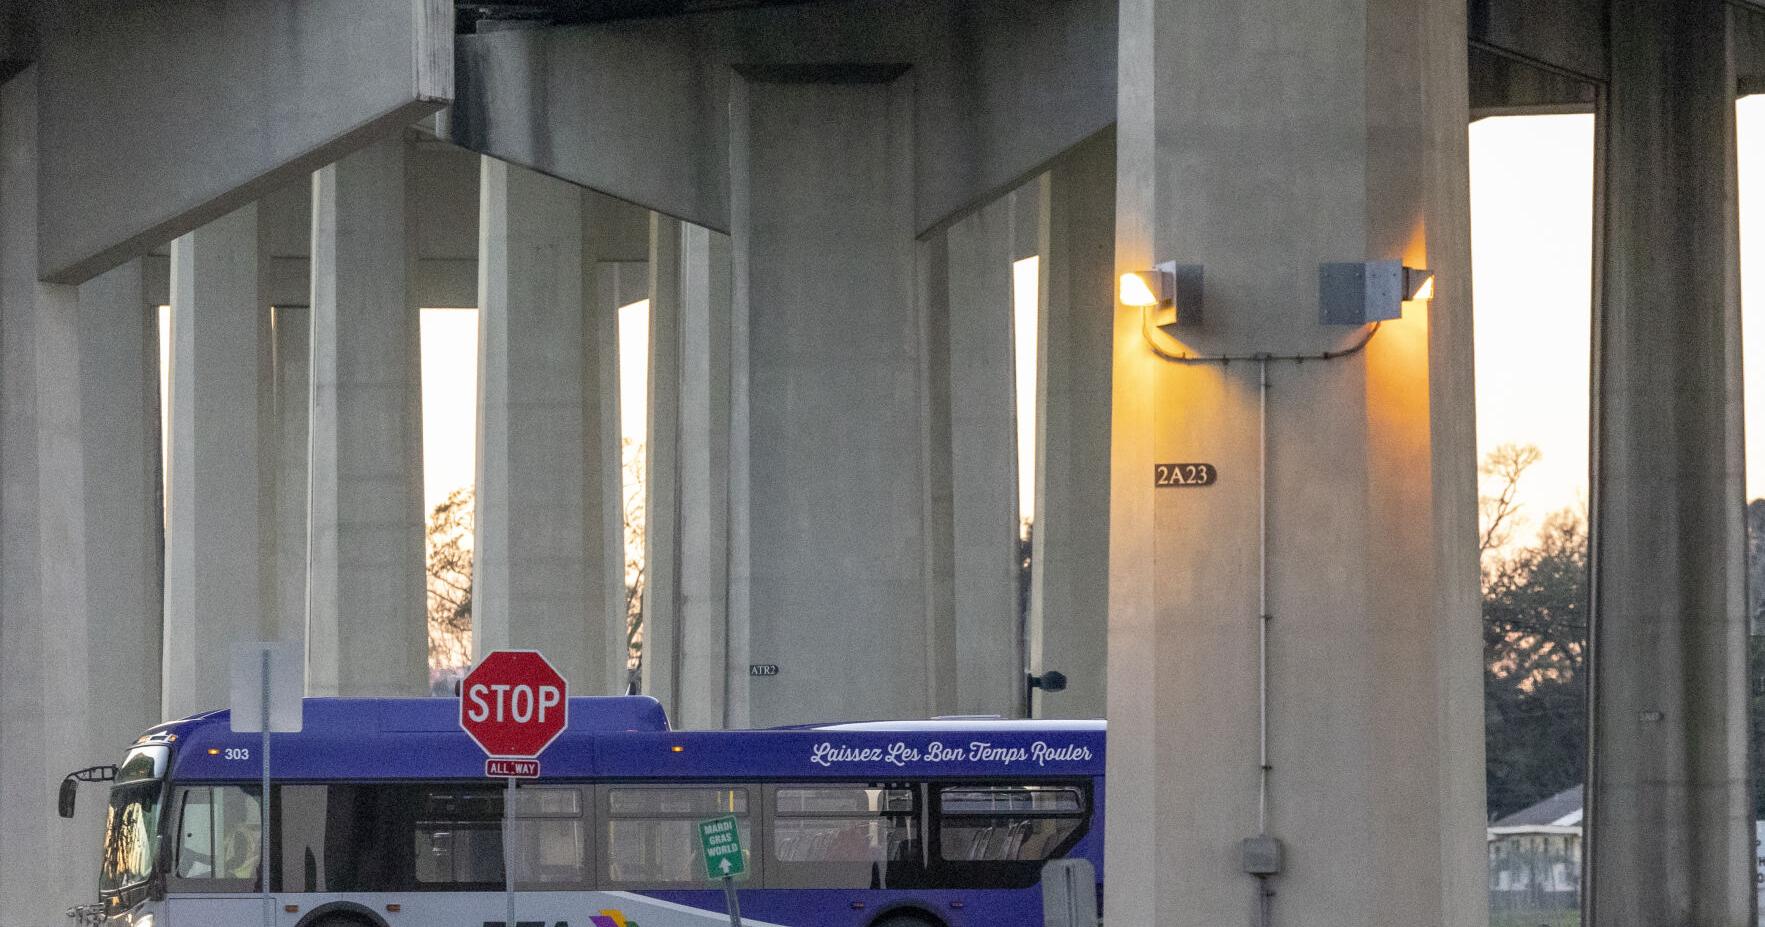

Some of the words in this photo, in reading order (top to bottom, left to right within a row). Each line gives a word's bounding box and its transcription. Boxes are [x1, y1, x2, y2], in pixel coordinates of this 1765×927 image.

[1158, 465, 1207, 484] 2A23
[751, 665, 776, 675] ATR2
[468, 684, 560, 723] STOP
[225, 748, 249, 760] 303
[810, 742, 882, 766] Laissez
[885, 742, 921, 766] Les
[924, 741, 966, 762] Bon
[969, 741, 1028, 765] Temps
[1031, 741, 1093, 766] Rouler
[490, 763, 508, 774] ALL
[515, 763, 536, 774] WAY
[704, 821, 733, 834] MARDI
[709, 832, 732, 845] GRAS
[708, 843, 738, 856] WORLD
